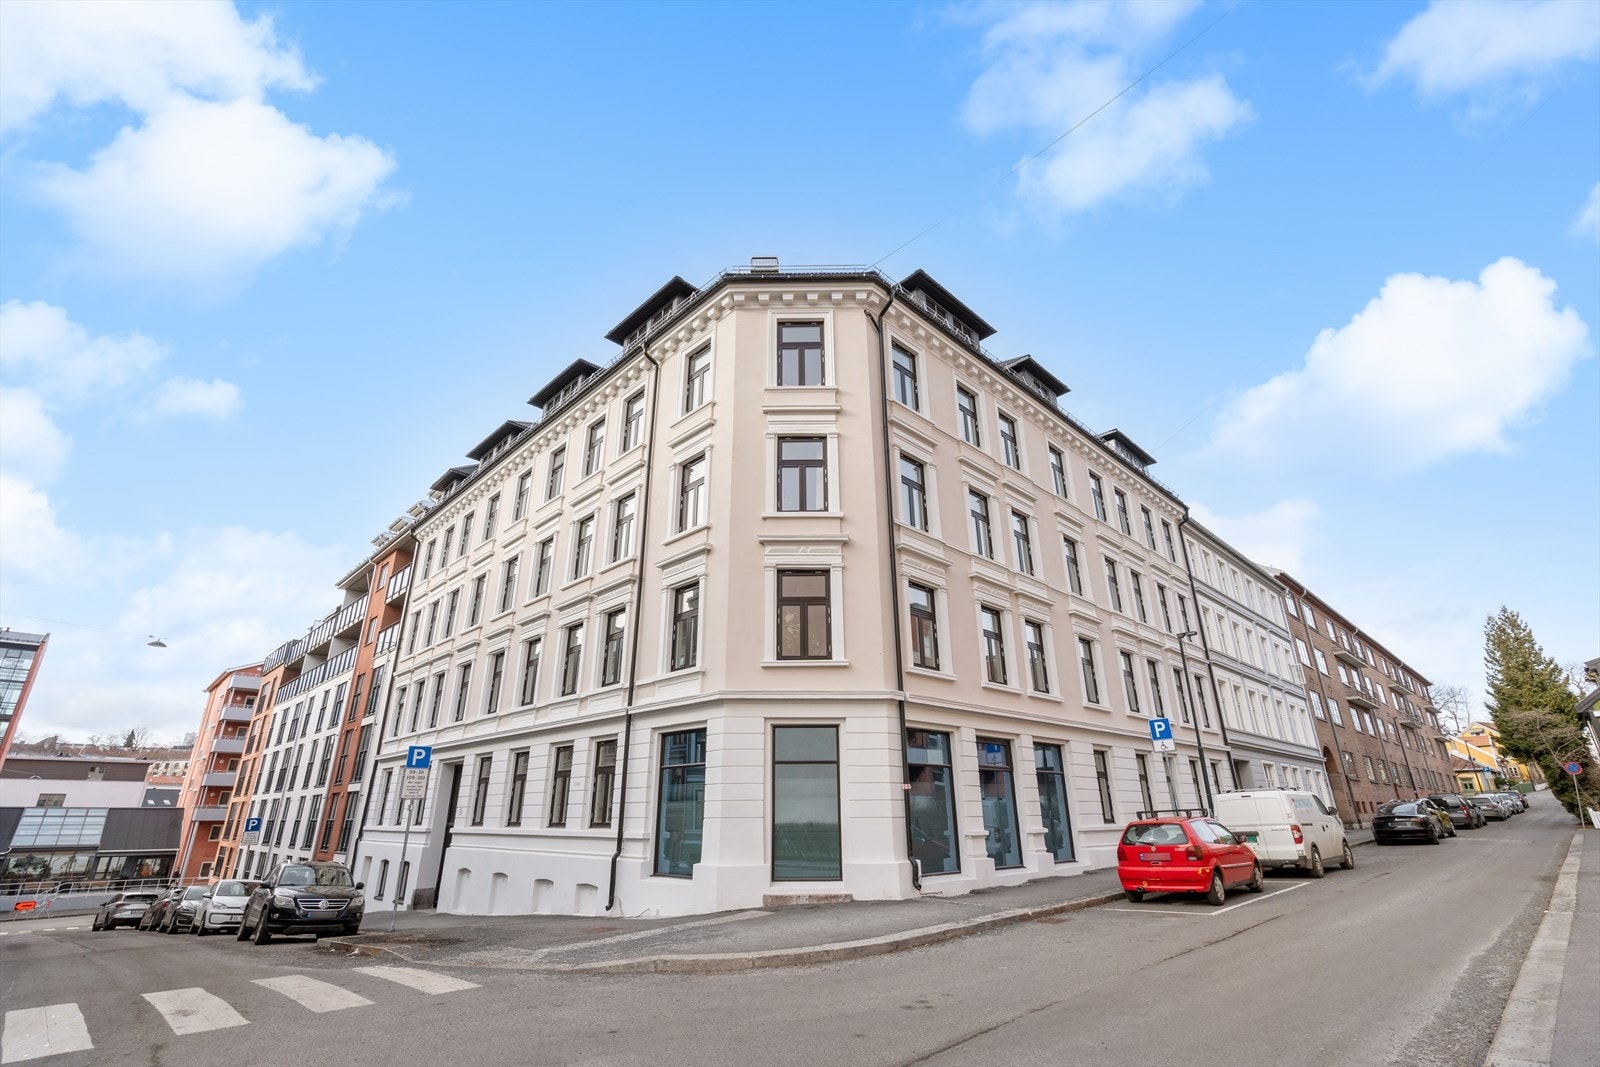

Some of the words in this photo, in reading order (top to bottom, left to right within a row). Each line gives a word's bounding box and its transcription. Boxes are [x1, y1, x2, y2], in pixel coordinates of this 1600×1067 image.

[1154, 722, 1166, 738] P
[412, 749, 426, 766] P
[248, 820, 258, 830] P
